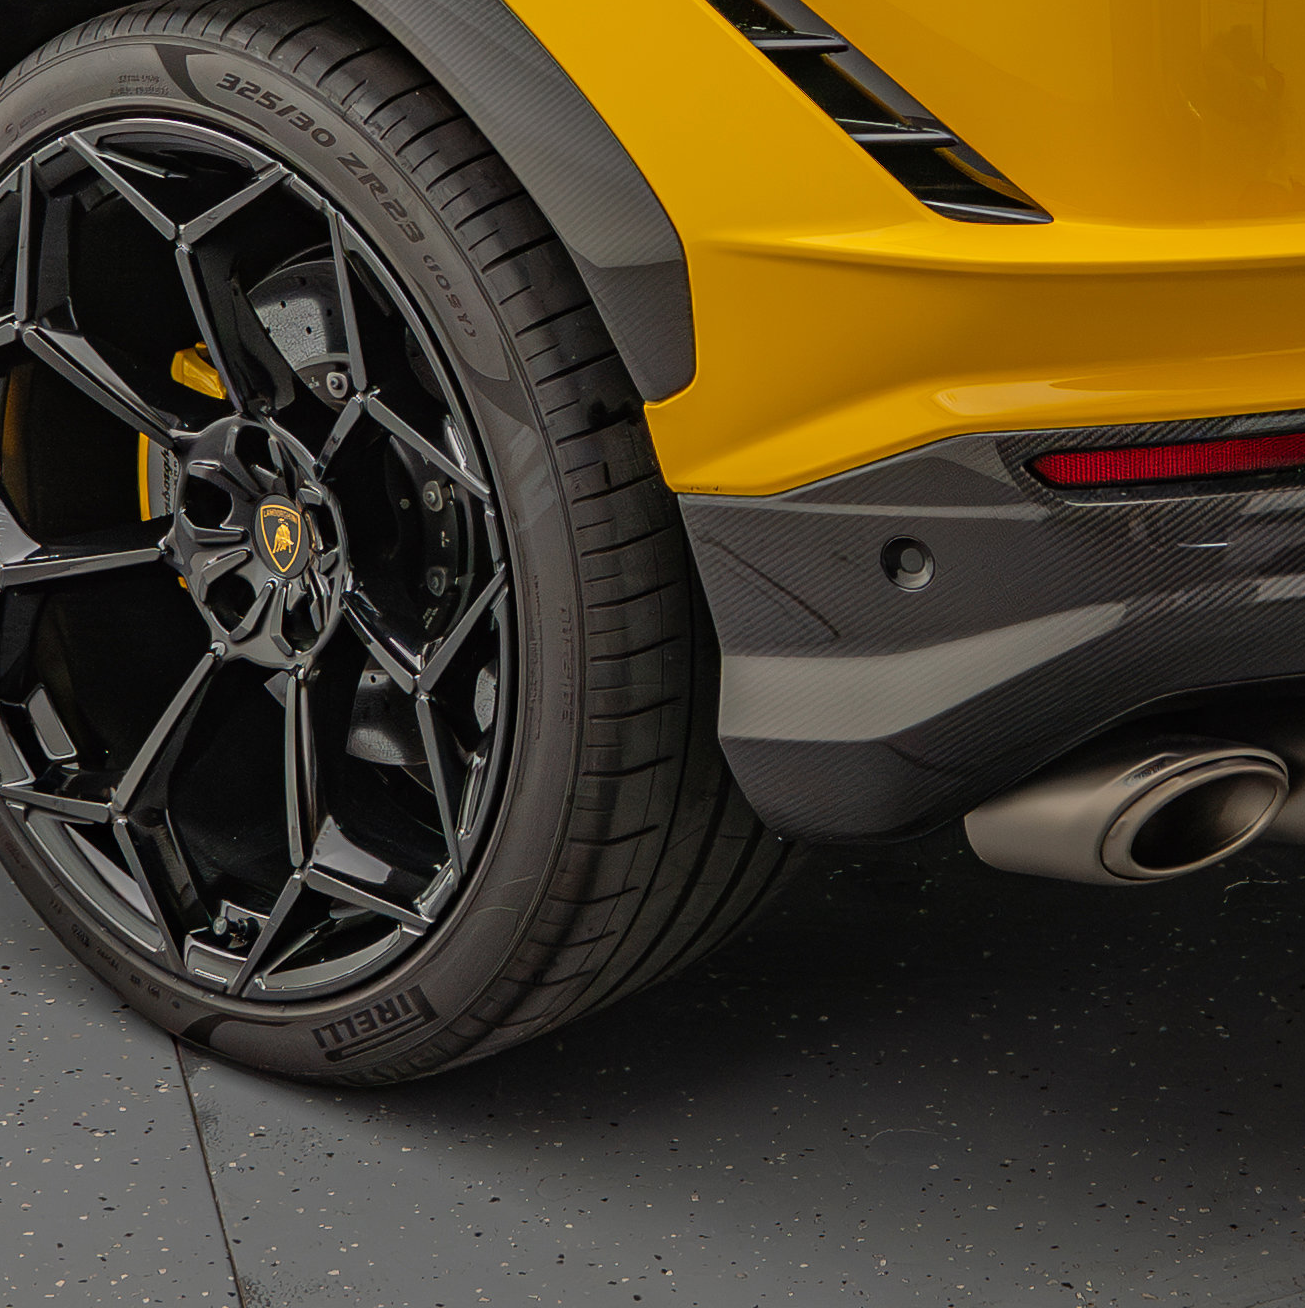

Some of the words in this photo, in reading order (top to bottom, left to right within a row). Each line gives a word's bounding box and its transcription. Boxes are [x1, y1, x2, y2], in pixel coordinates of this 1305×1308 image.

[216, 72, 337, 148] 325/30
[336, 151, 426, 244] ZR23
[311, 984, 439, 1063] PIRELLI
